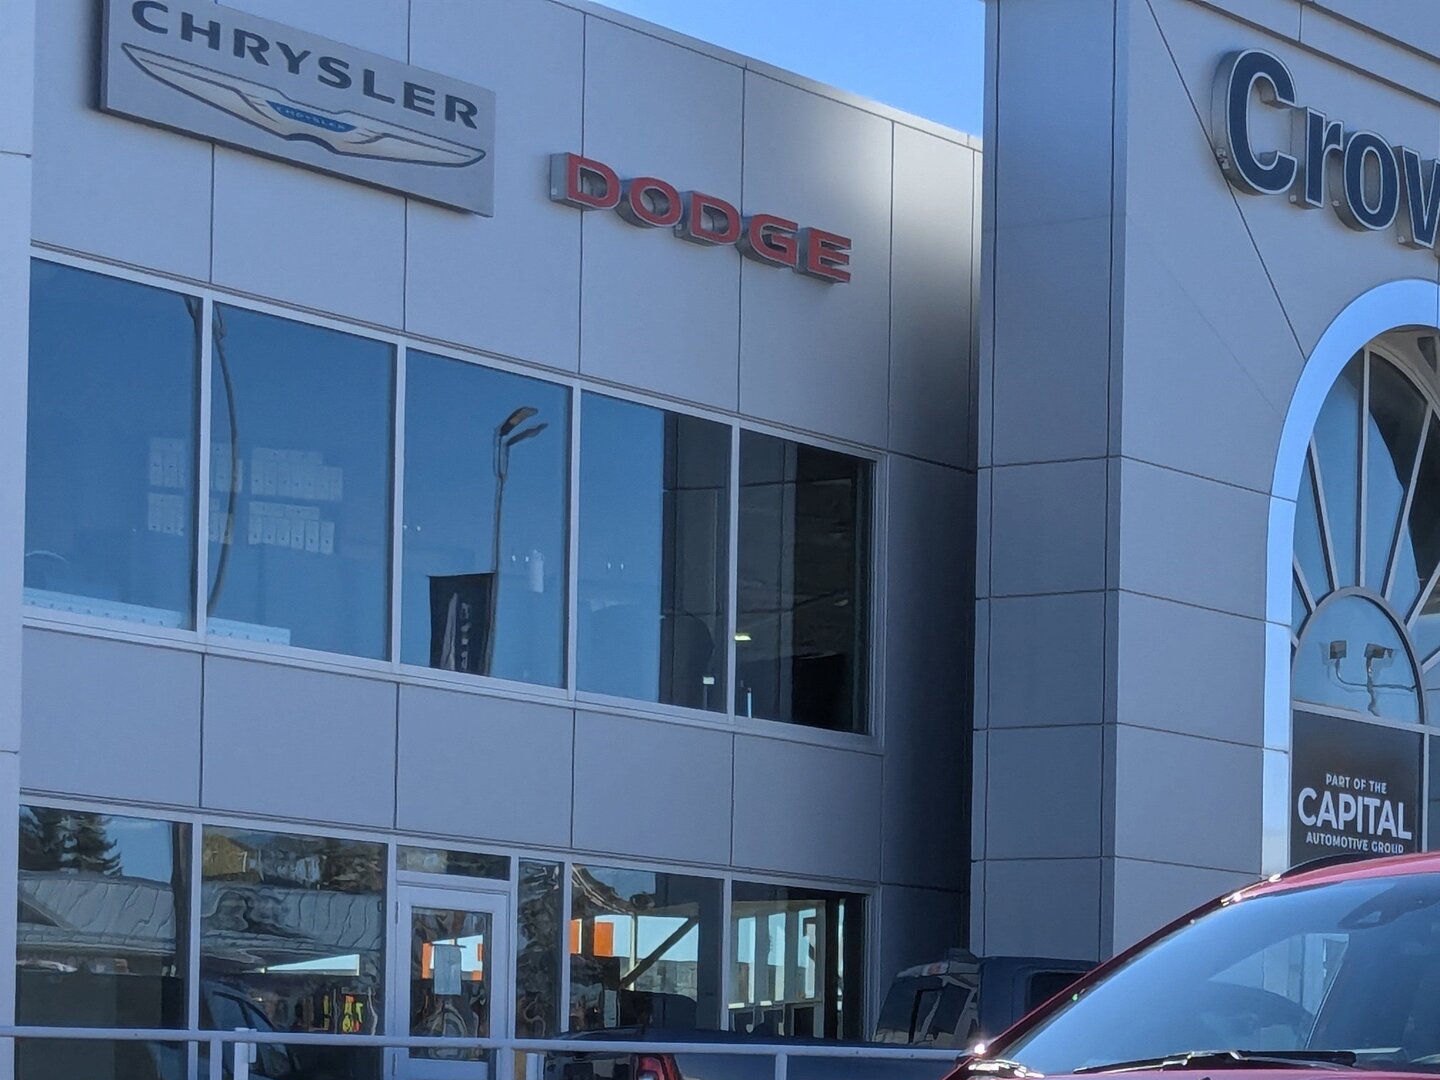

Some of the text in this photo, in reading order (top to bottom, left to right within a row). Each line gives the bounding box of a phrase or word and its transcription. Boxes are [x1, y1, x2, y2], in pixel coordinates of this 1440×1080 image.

[132, 1, 478, 129] CHRYSLER
[562, 152, 852, 284] DODGE
[1325, 773, 1388, 794] PART OF THE
[1297, 787, 1412, 840] CAPITAL
[1305, 831, 1405, 855] AUTOMOTIVE GROUP
